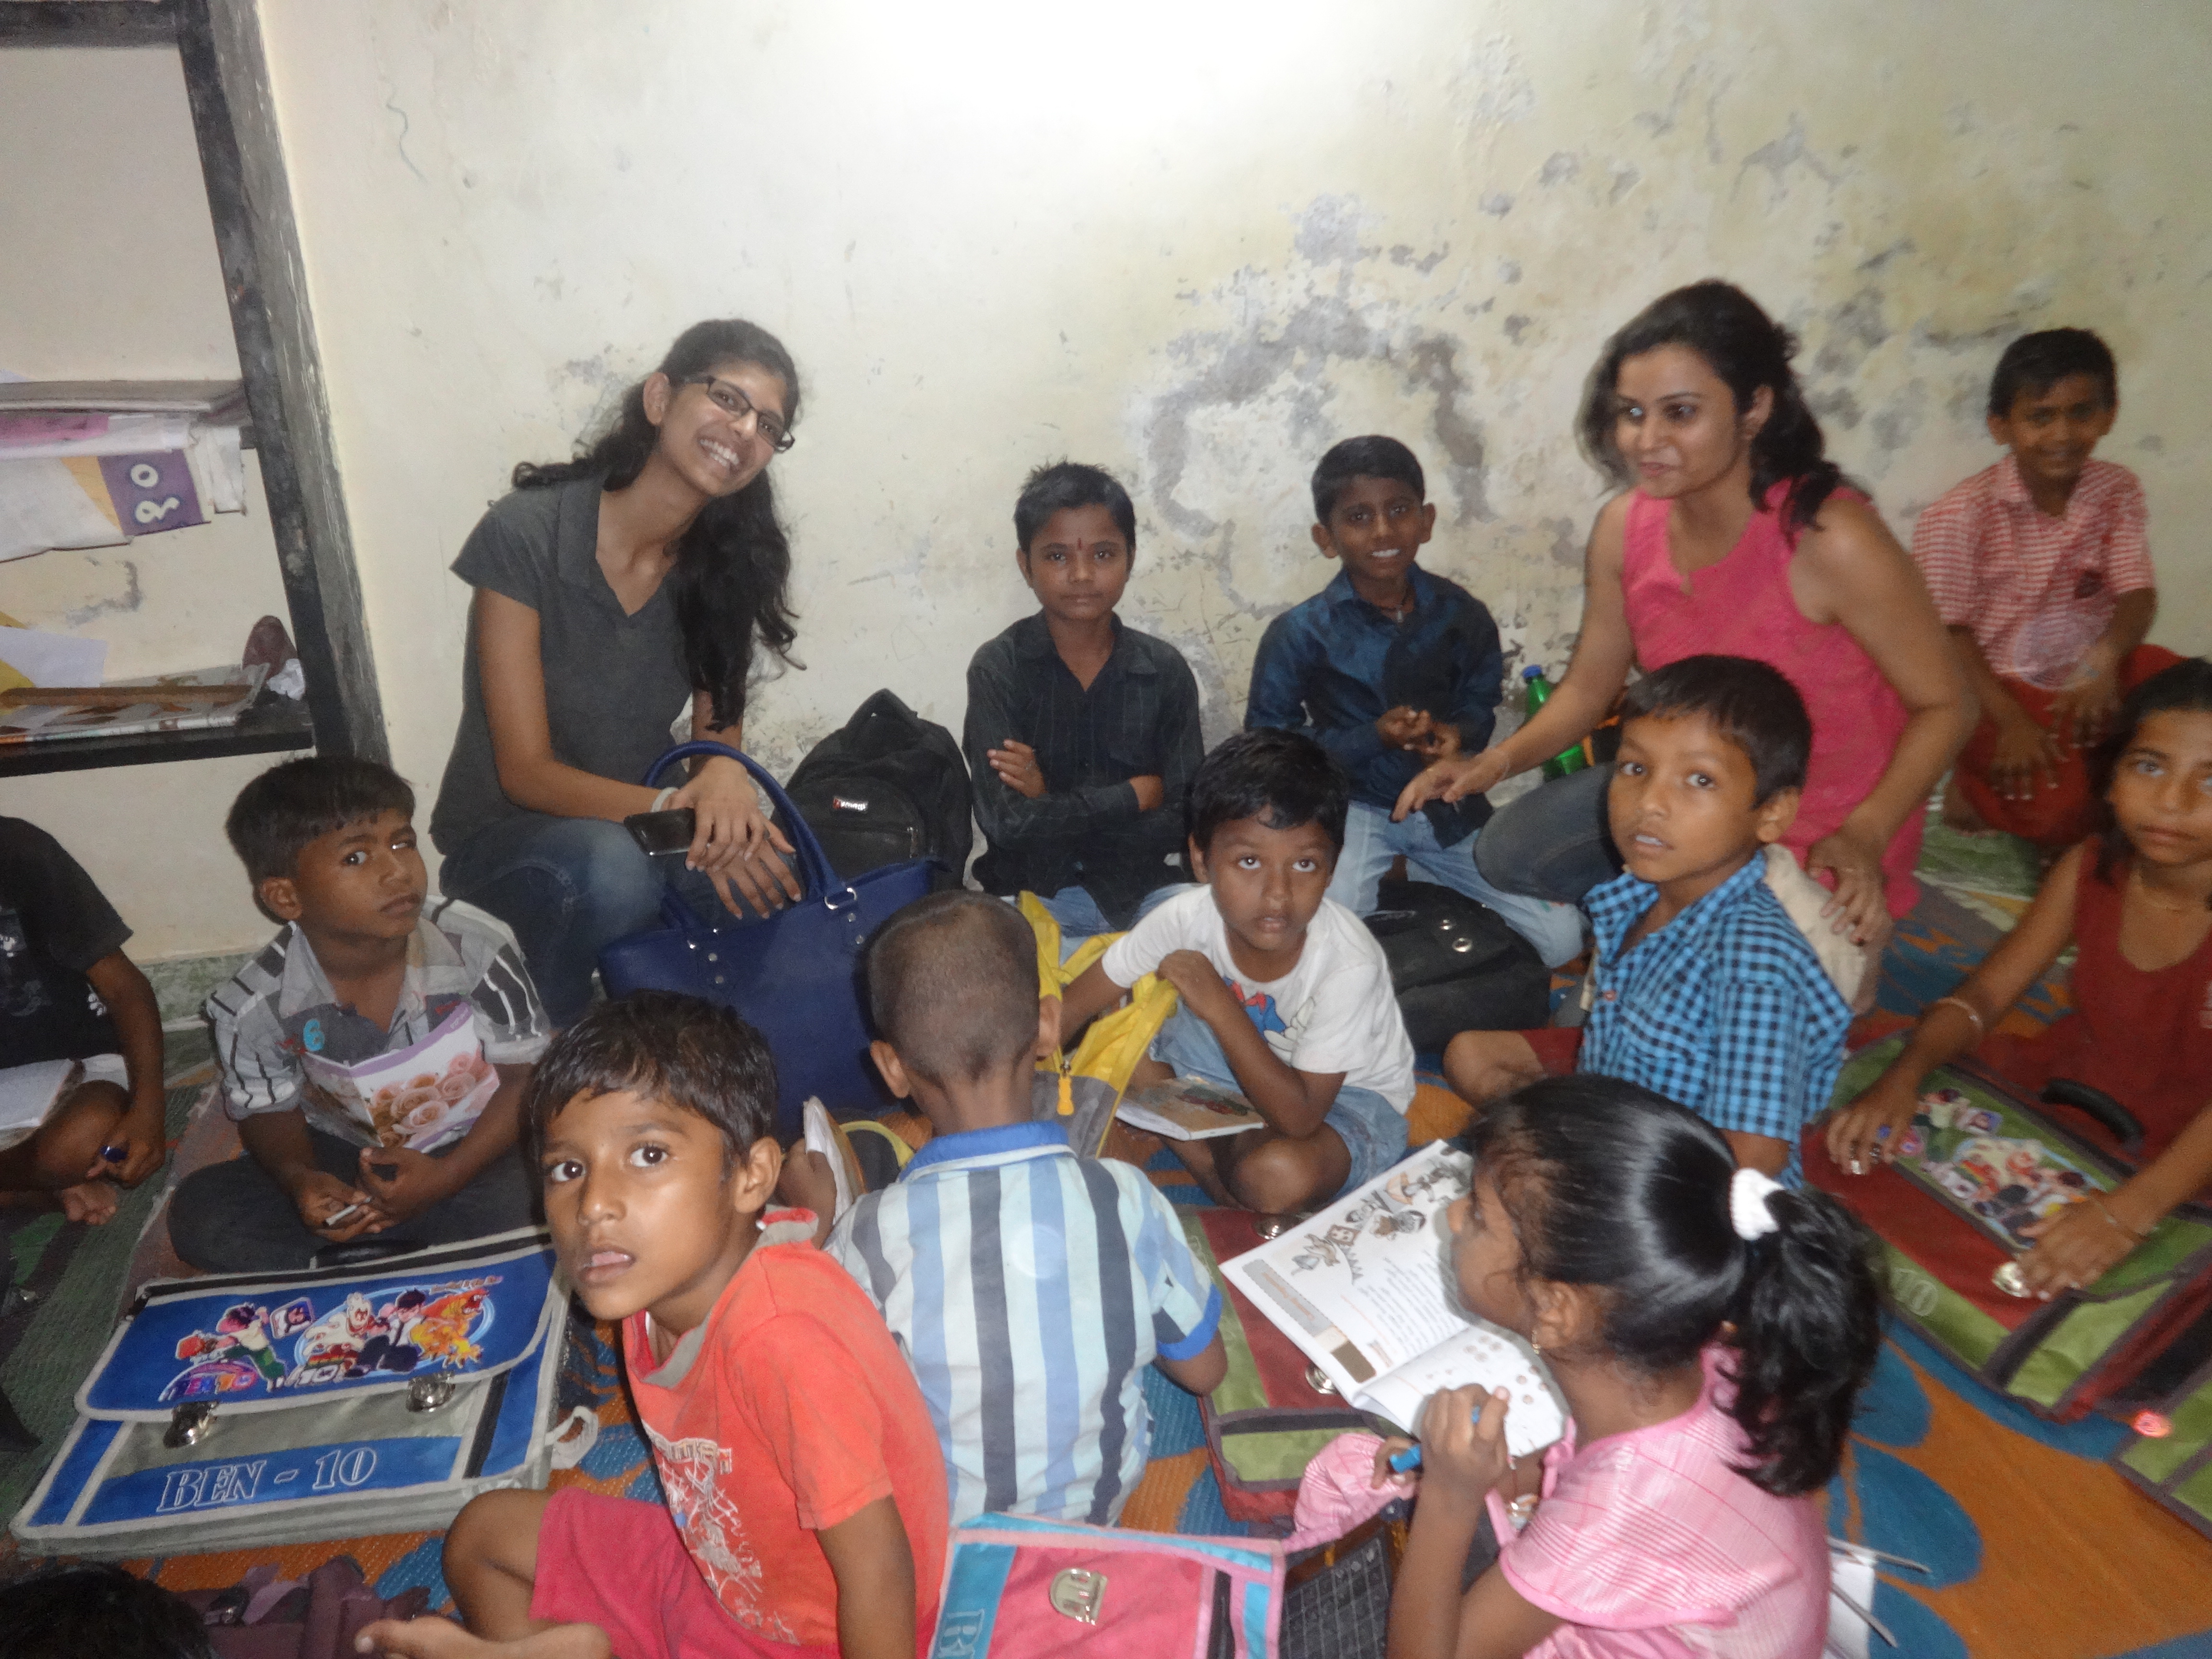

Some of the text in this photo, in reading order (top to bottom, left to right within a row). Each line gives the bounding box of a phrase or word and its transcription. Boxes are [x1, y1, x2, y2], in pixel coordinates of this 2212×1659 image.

[303, 1018, 325, 1052] 6
[156, 1447, 377, 1512] BEN - 10
